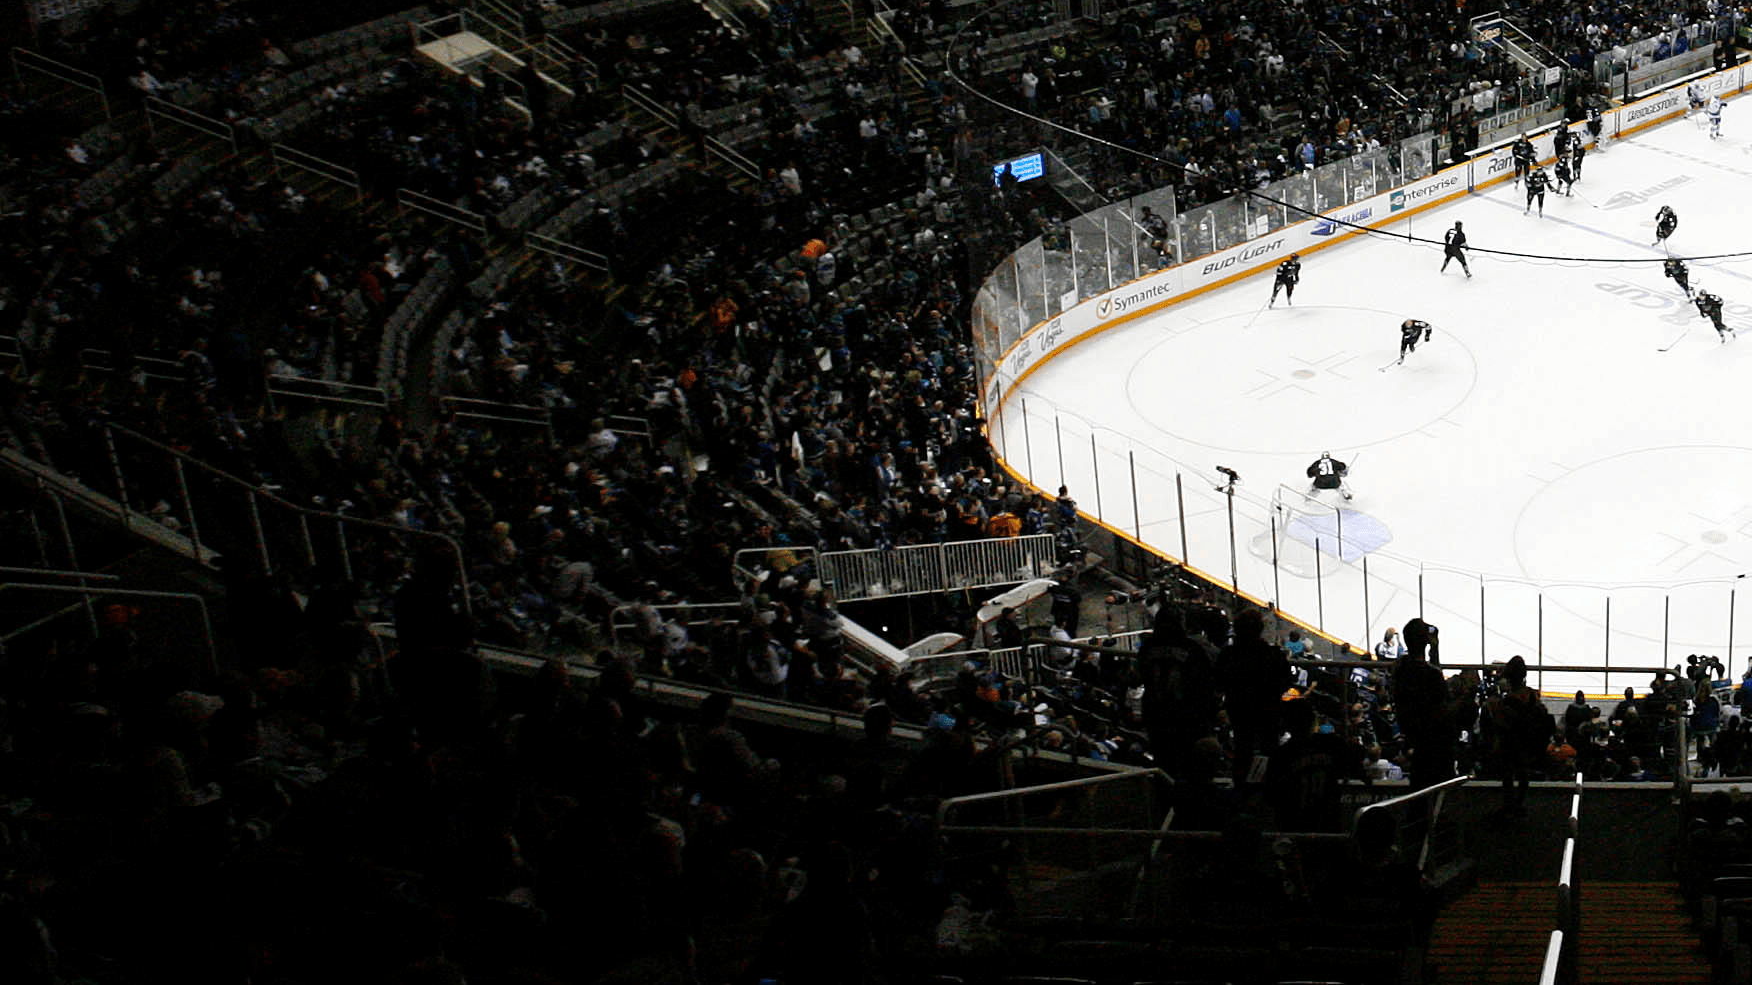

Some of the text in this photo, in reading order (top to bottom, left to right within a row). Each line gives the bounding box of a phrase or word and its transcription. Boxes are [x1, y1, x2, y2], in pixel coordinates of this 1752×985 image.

[1627, 95, 1680, 122] BRIDGESTONE
[1391, 175, 1458, 206] enterprise
[1202, 238, 1285, 275] BUD LIGHT
[1114, 283, 1170, 311] Symantec
[1593, 283, 1676, 310] CUP
